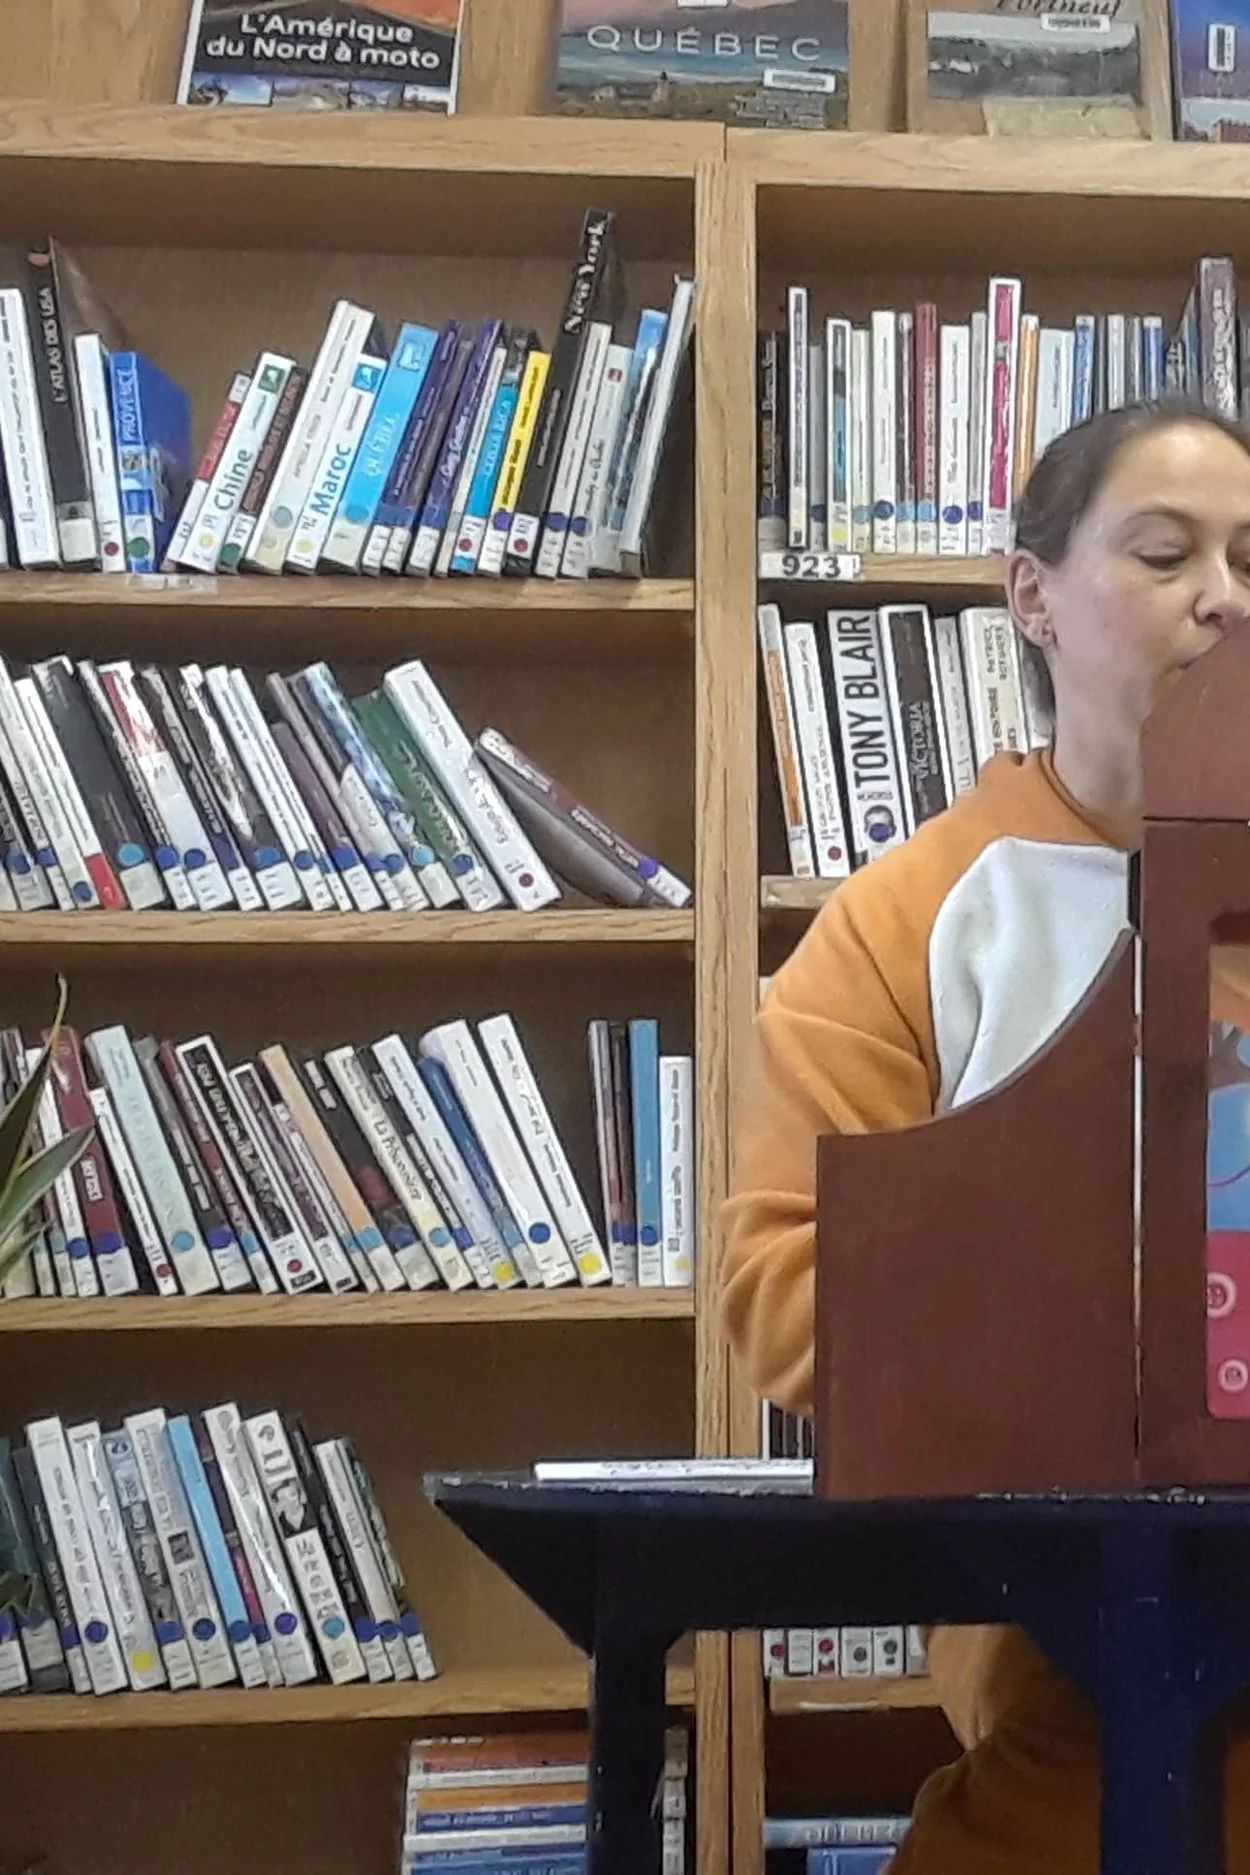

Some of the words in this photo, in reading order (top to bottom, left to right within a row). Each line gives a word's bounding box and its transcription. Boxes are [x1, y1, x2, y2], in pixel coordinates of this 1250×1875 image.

[206, 36, 244, 57] du
[253, 37, 327, 61] Nord
[334, 42, 351, 62] à
[360, 46, 440, 69] moto
[241, 13, 413, 43] L'Amérique
[588, 25, 820, 61] QUÉBEC
[213, 448, 254, 510] Chine
[309, 443, 352, 517] Maroc
[782, 555, 842, 579] 923
[837, 614, 880, 701] BLAIR
[848, 711, 892, 789] TONY
